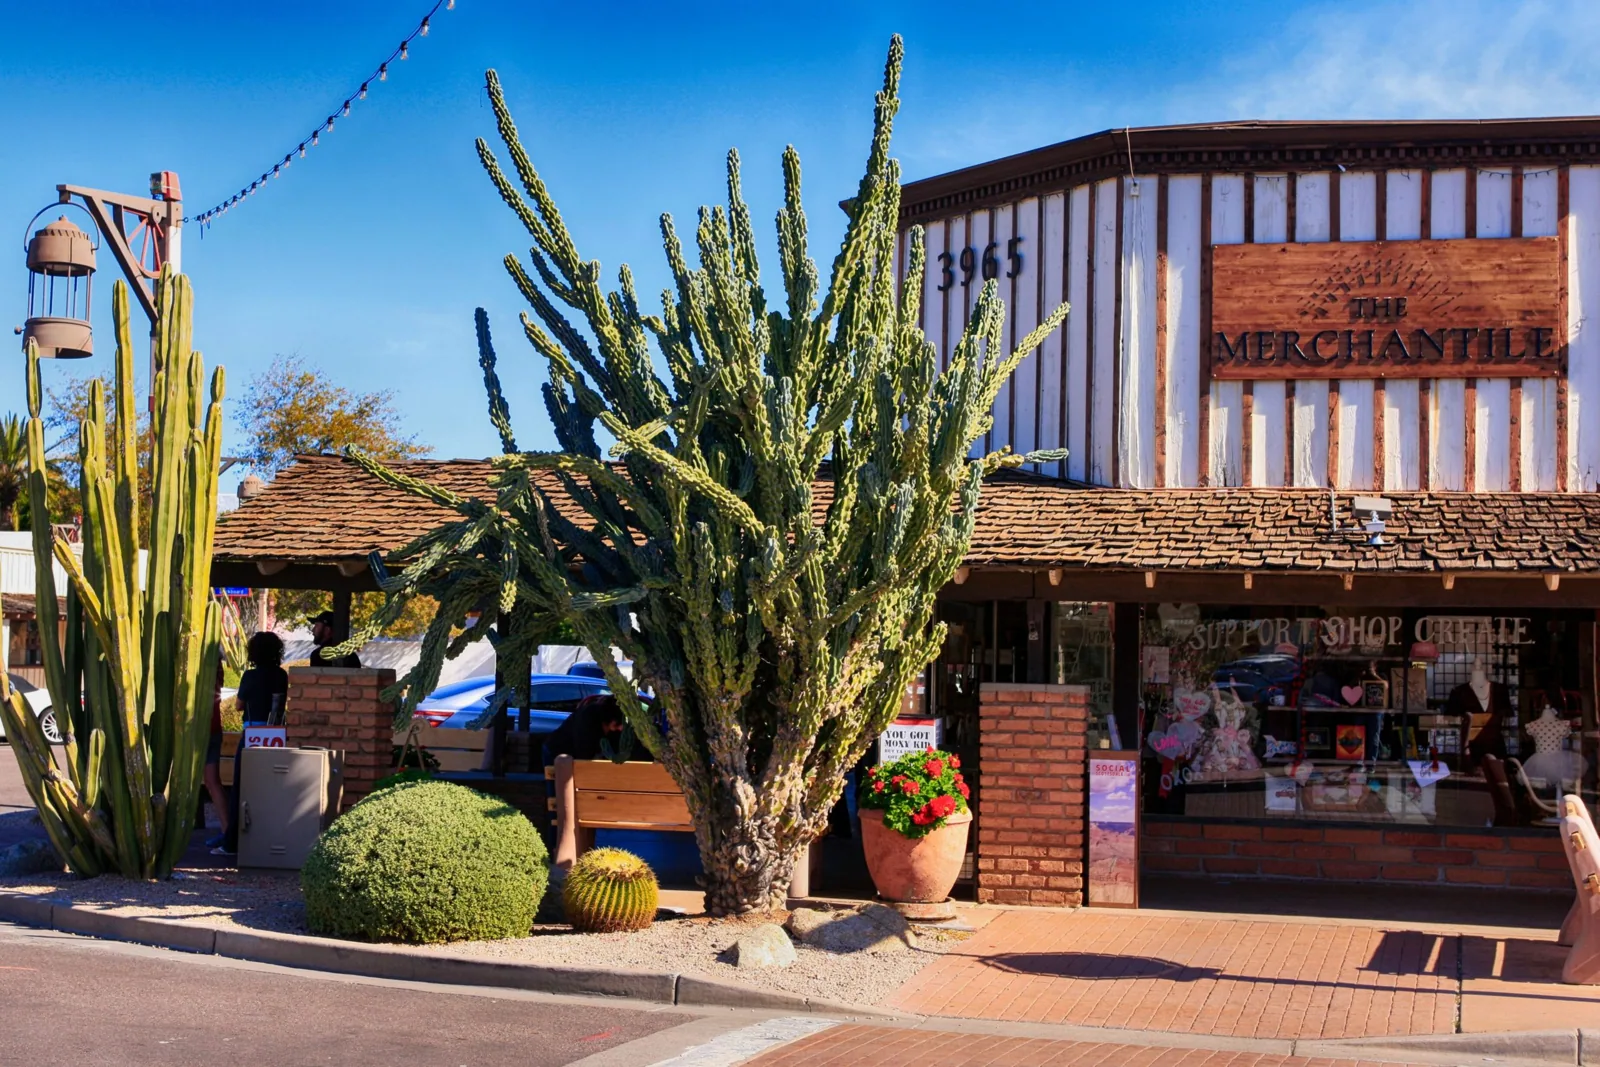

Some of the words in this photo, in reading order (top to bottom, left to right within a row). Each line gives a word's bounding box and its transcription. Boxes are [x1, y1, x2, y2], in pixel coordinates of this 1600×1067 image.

[937, 237, 1022, 291] 3965
[1352, 296, 1408, 318] THE
[1216, 327, 1555, 362] MERCHANTILE
[885, 730, 907, 740] YOU
[909, 731, 931, 740] GOT
[884, 739, 910, 748] MOXY
[1095, 764, 1131, 773] SOCIAL
